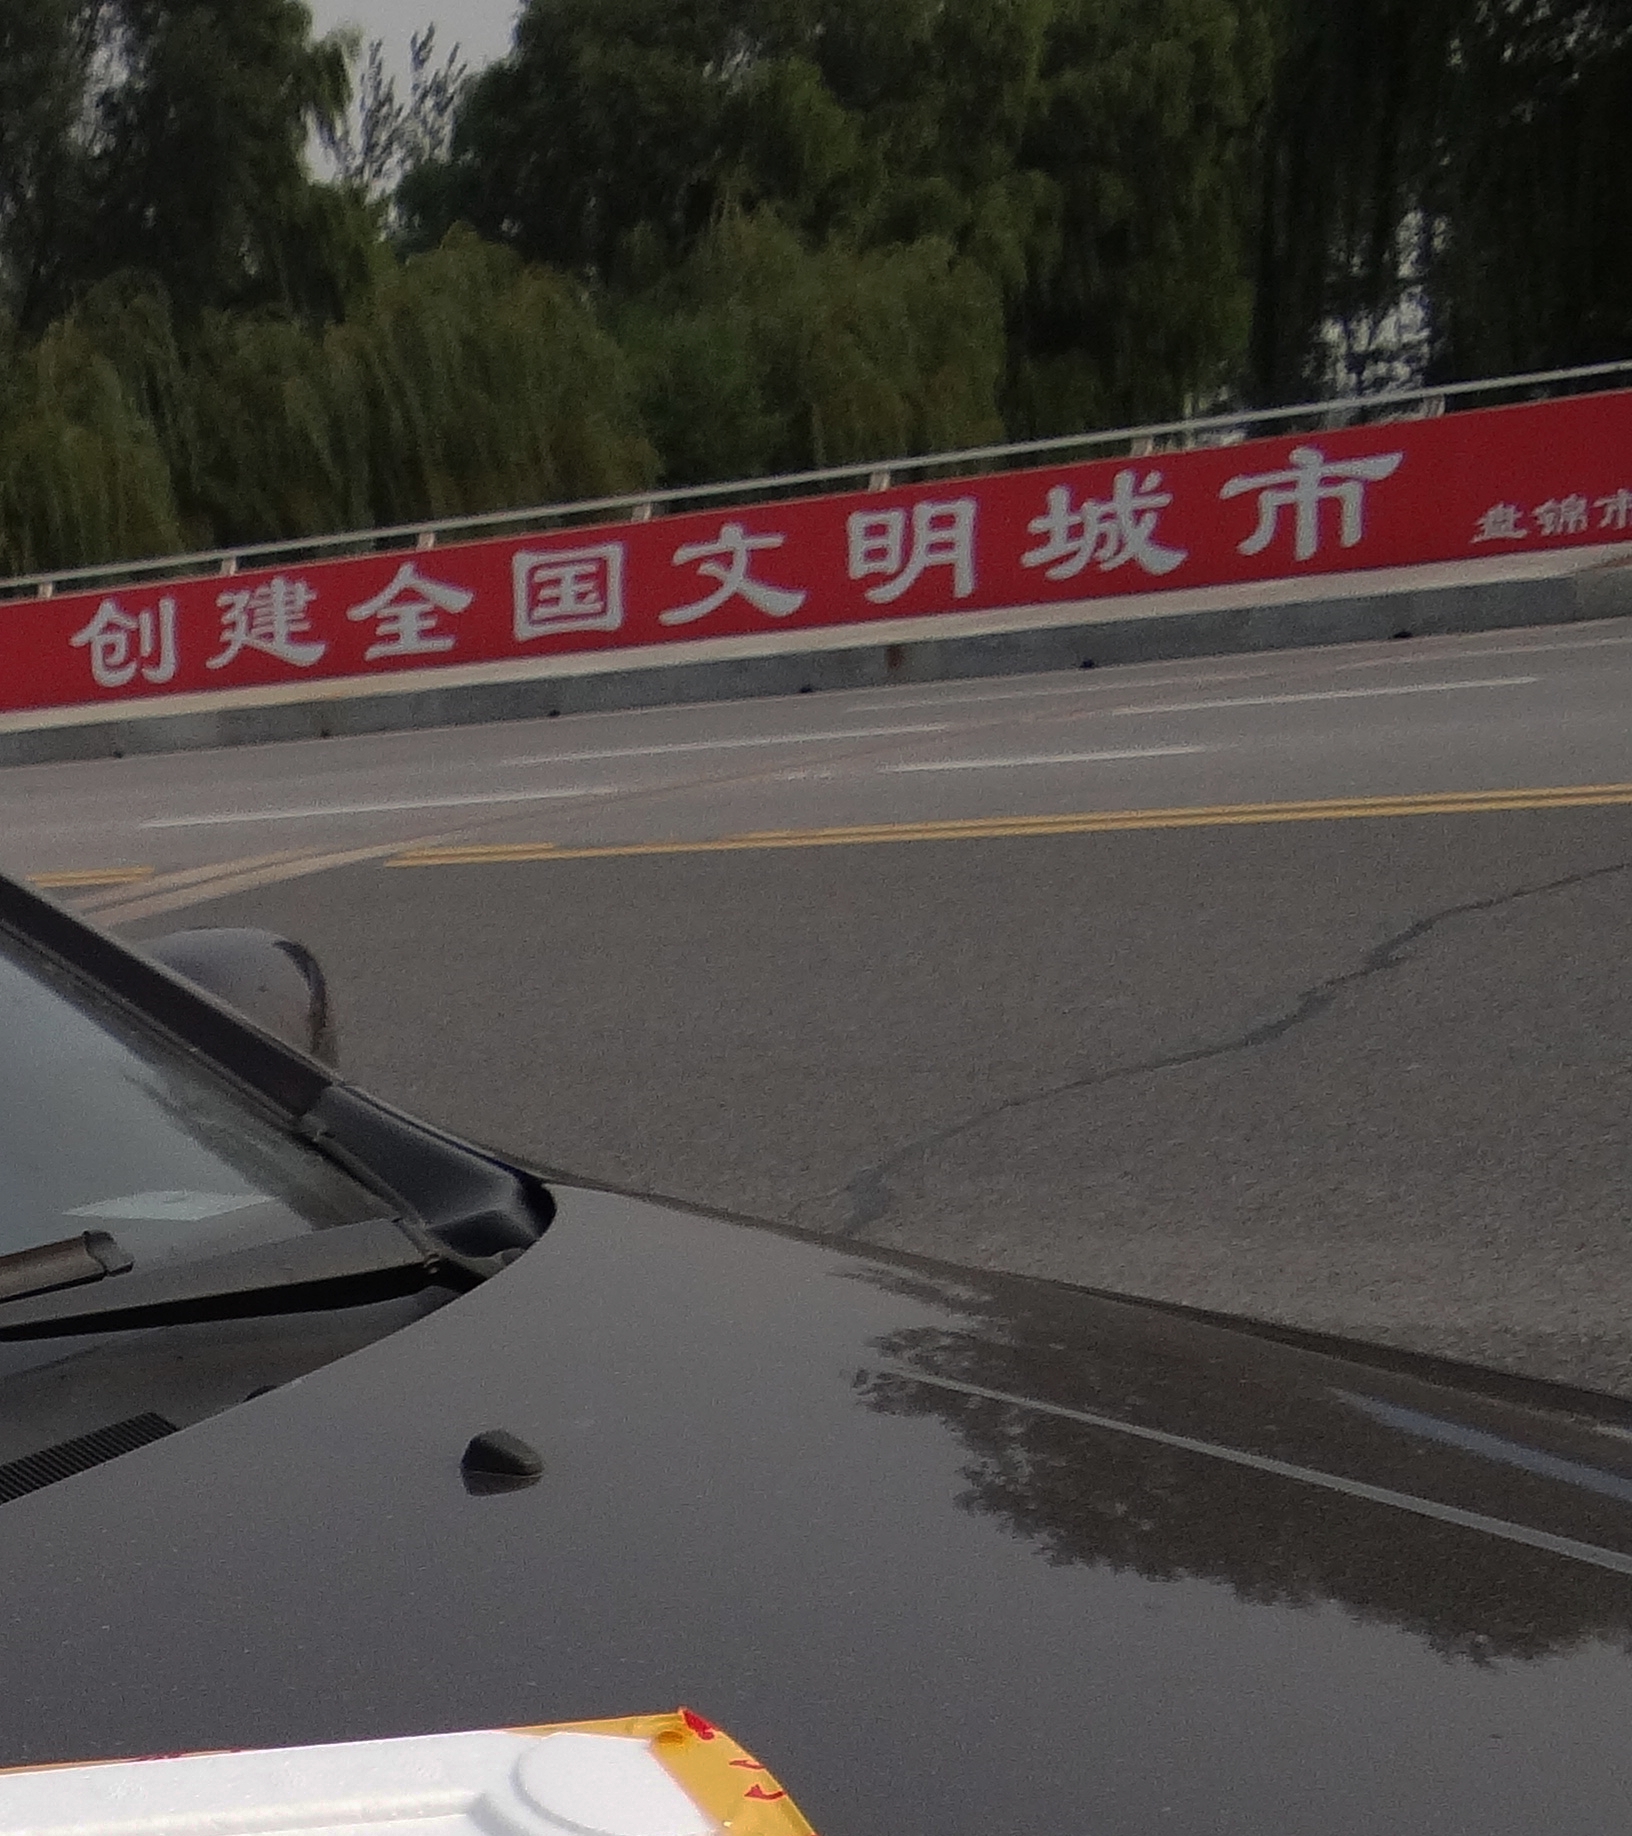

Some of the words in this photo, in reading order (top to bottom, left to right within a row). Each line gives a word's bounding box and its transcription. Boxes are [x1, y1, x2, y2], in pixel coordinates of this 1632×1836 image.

[70, 448, 1404, 688] 创建全国文明城市
